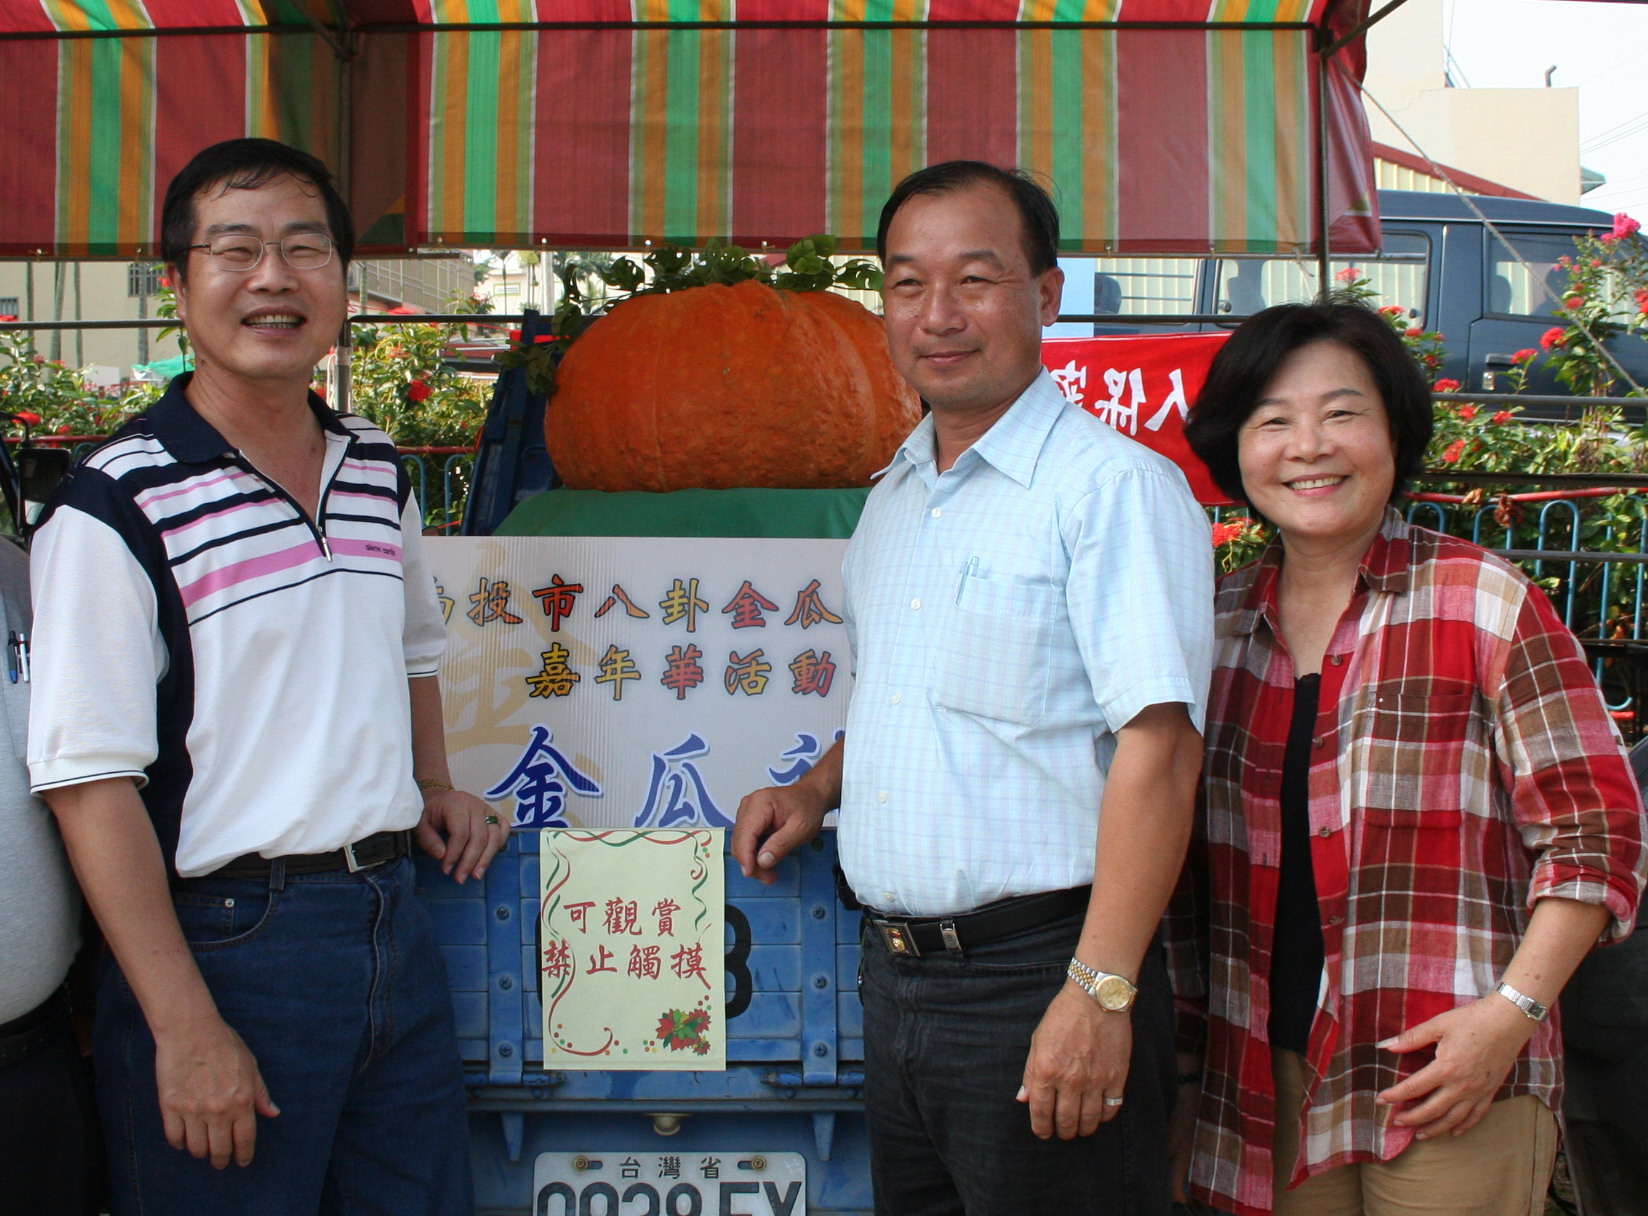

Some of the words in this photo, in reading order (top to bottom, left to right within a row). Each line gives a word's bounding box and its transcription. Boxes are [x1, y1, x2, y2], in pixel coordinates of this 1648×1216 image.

[526, 642, 837, 700] 嘉年華活動
[563, 897, 682, 937] 可觀賞
[541, 938, 711, 990] 禁止觸摸
[619, 1156, 721, 1179] 台灣省
